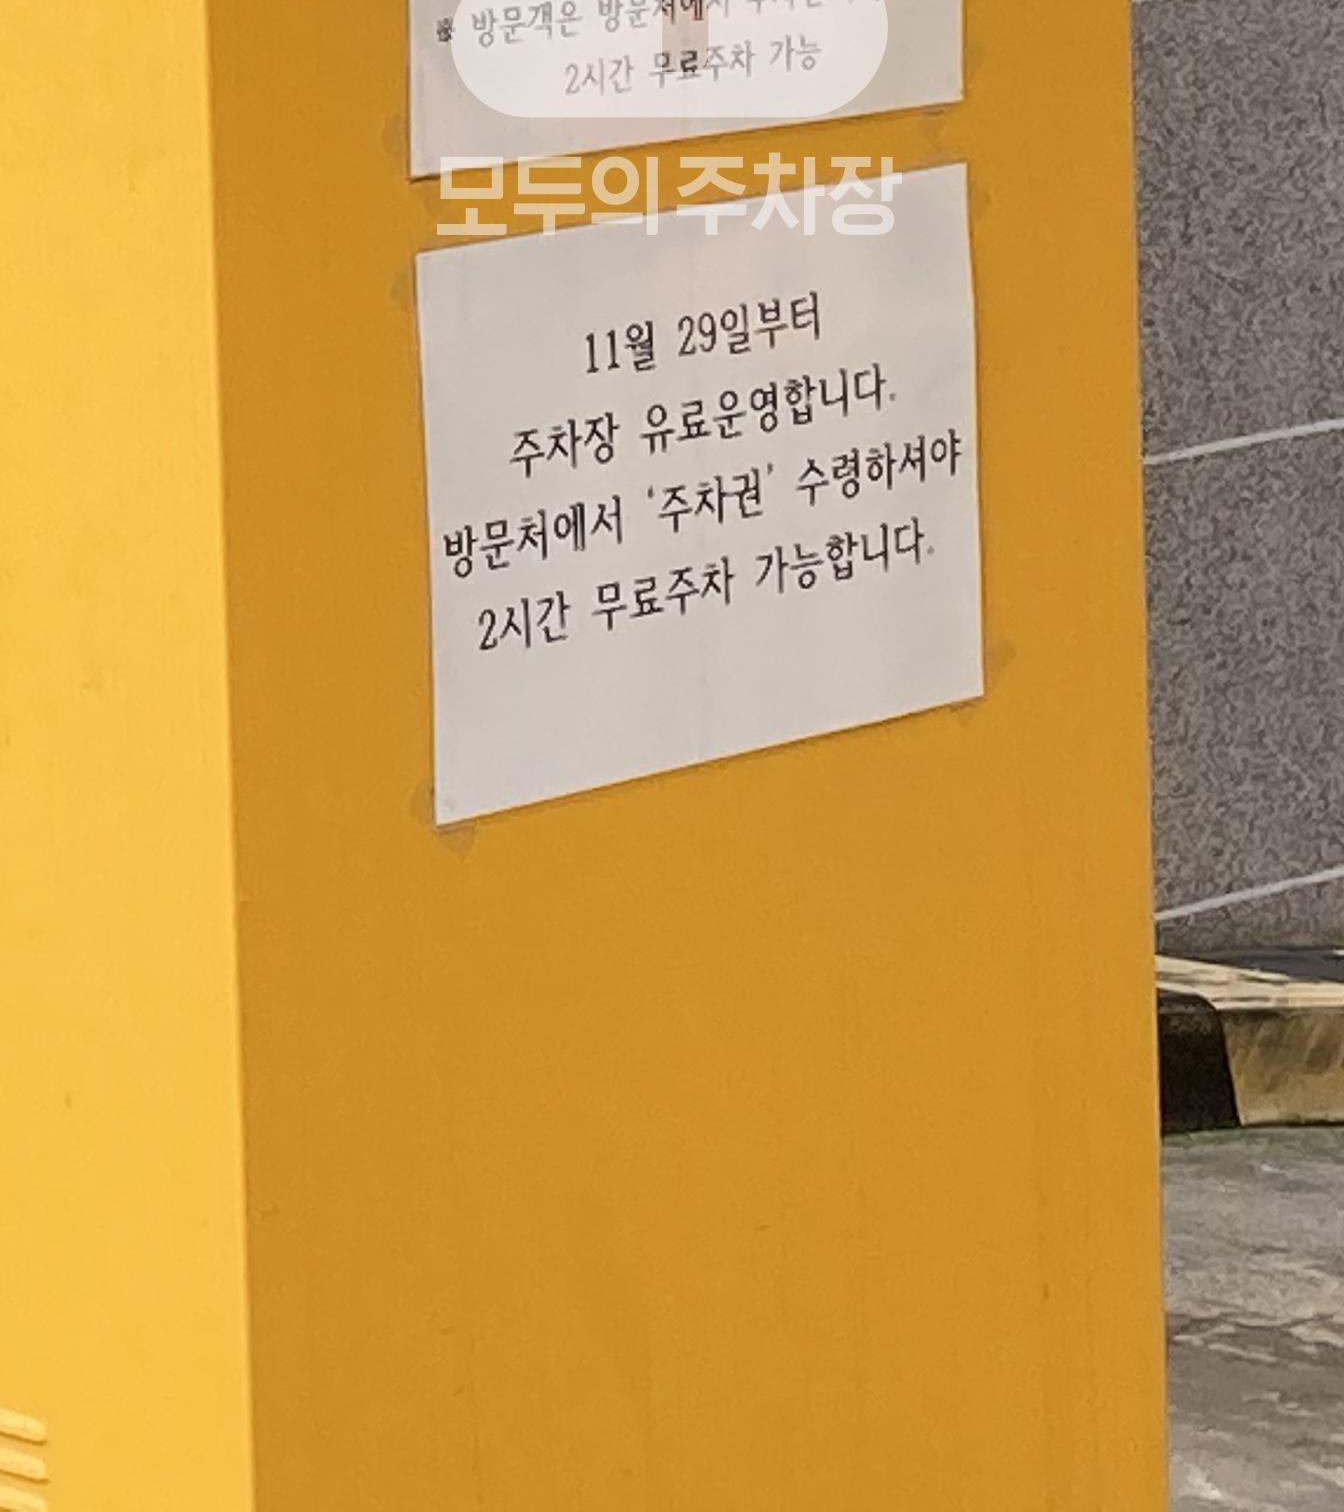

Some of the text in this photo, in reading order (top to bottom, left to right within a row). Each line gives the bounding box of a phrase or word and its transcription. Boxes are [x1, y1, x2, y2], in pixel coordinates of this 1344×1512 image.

[471, 0, 583, 49] 방문객은
[564, 34, 823, 96] 2시간 무료주차 가능
[584, 290, 823, 374] 11월 29일부터
[509, 362, 898, 479] 주차장 유료운영합니다.
[443, 495, 624, 579] 방문처에서
[796, 427, 963, 507] 수령하셔야
[477, 516, 936, 651] 2시간 무료주차 가능합니다.
